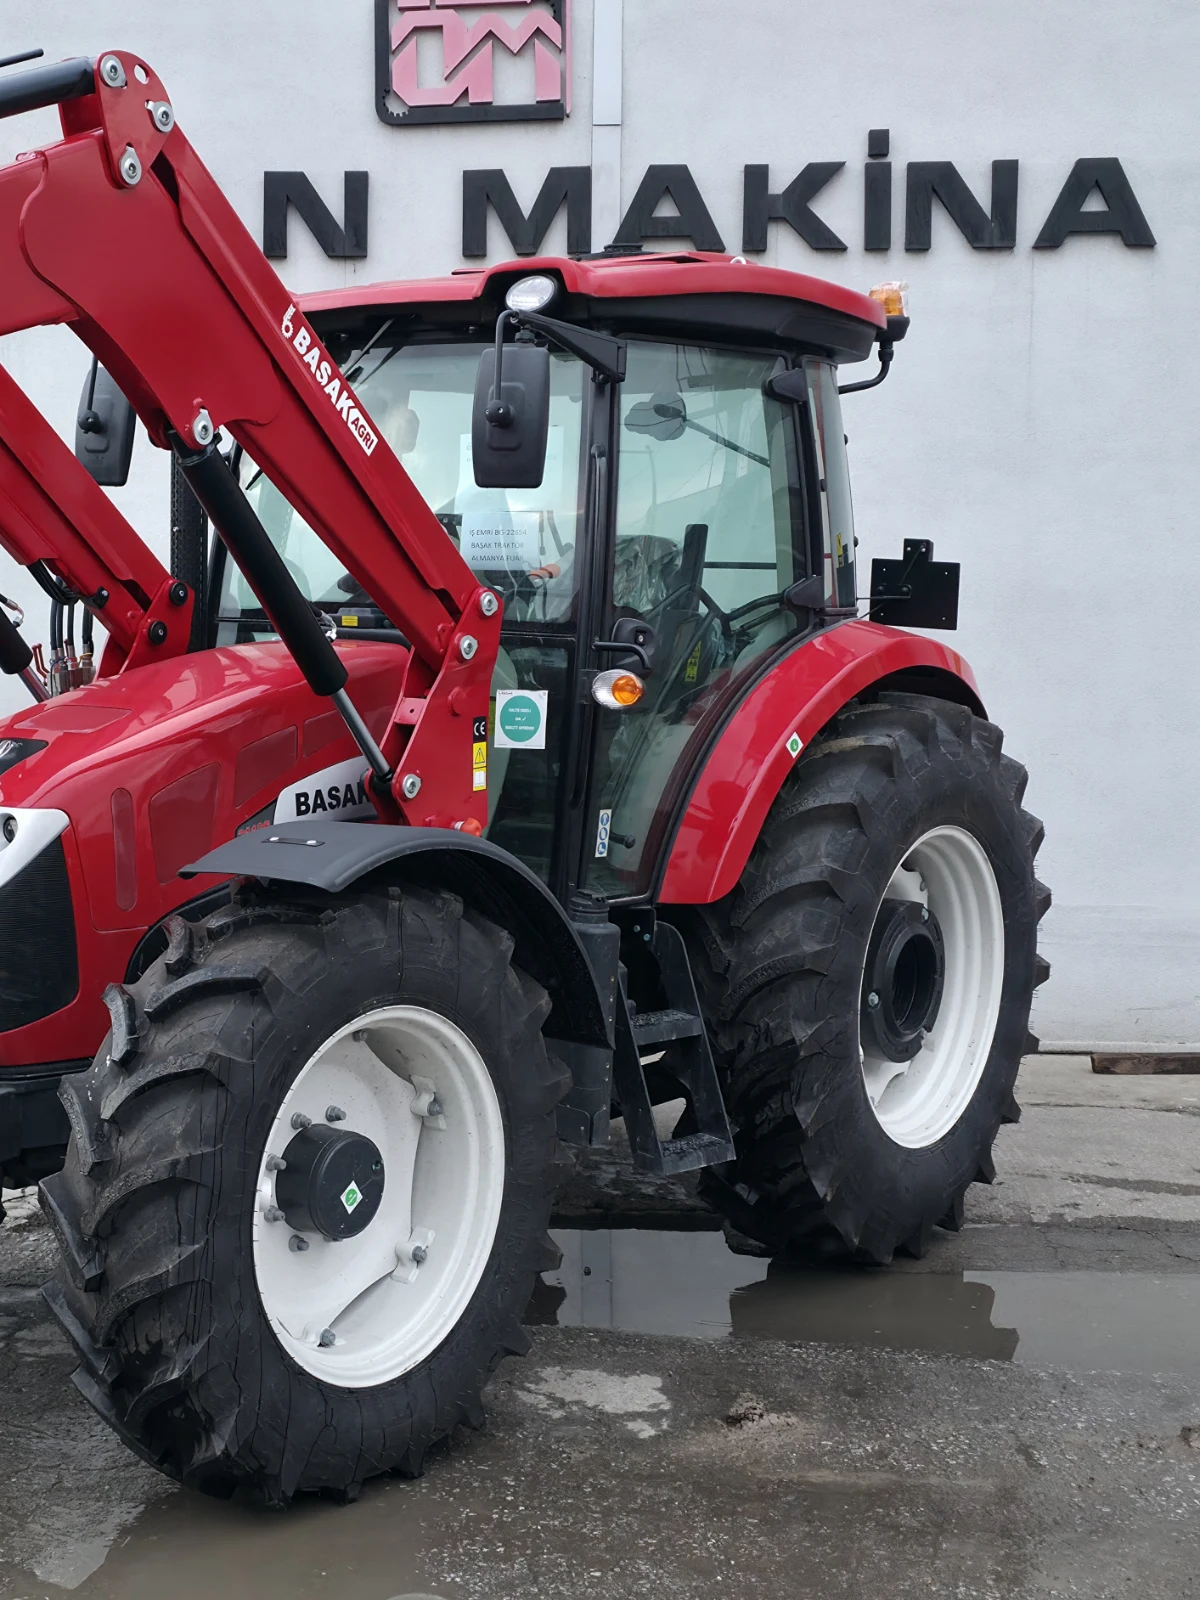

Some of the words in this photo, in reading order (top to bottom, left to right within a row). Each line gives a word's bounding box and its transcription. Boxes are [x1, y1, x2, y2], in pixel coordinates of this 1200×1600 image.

[462, 129, 1156, 257] MAKİNA
[351, 417, 375, 450] AGRI
[474, 721, 486, 736] CE
